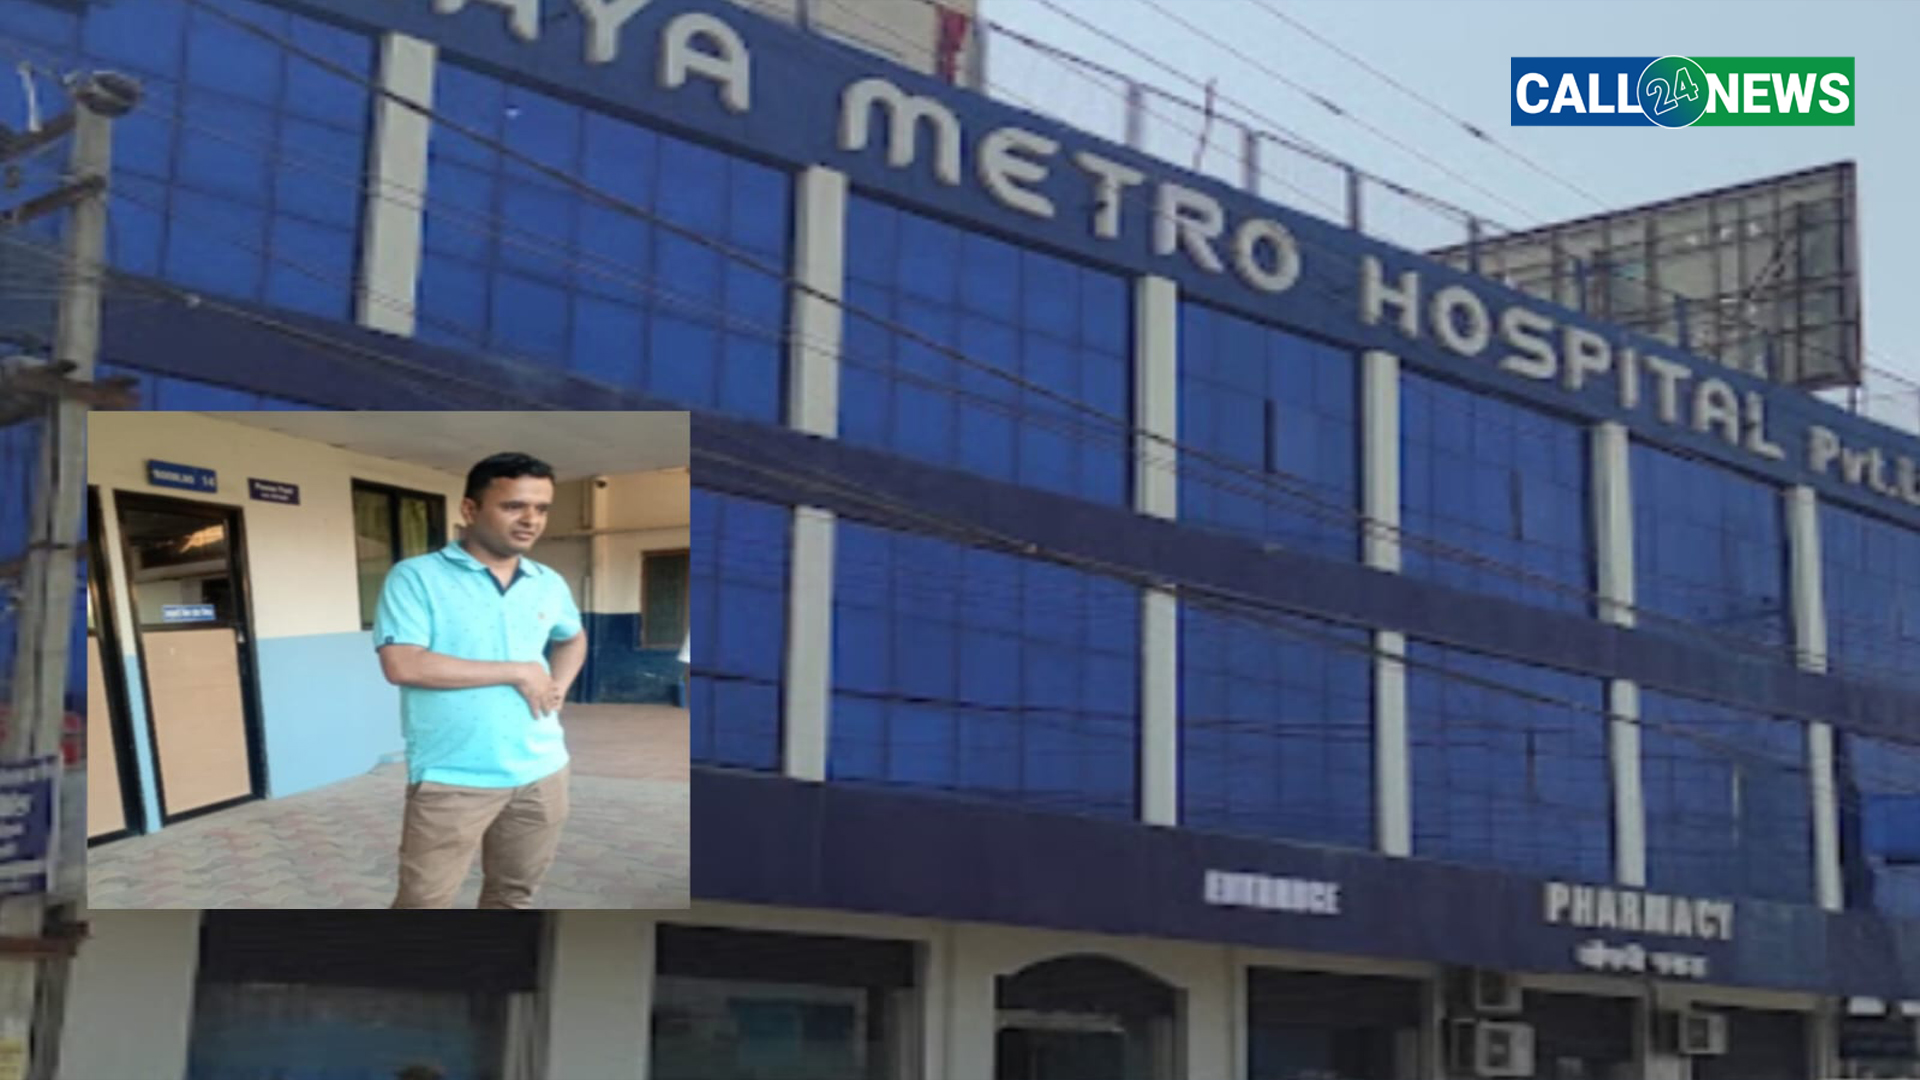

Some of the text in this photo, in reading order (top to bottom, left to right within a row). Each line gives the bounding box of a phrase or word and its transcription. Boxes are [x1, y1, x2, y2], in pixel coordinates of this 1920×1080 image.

[841, 79, 1300, 292] METRO
[1361, 256, 1785, 459] HOSPITAL
[1545, 882, 1735, 940] PHARMACY
